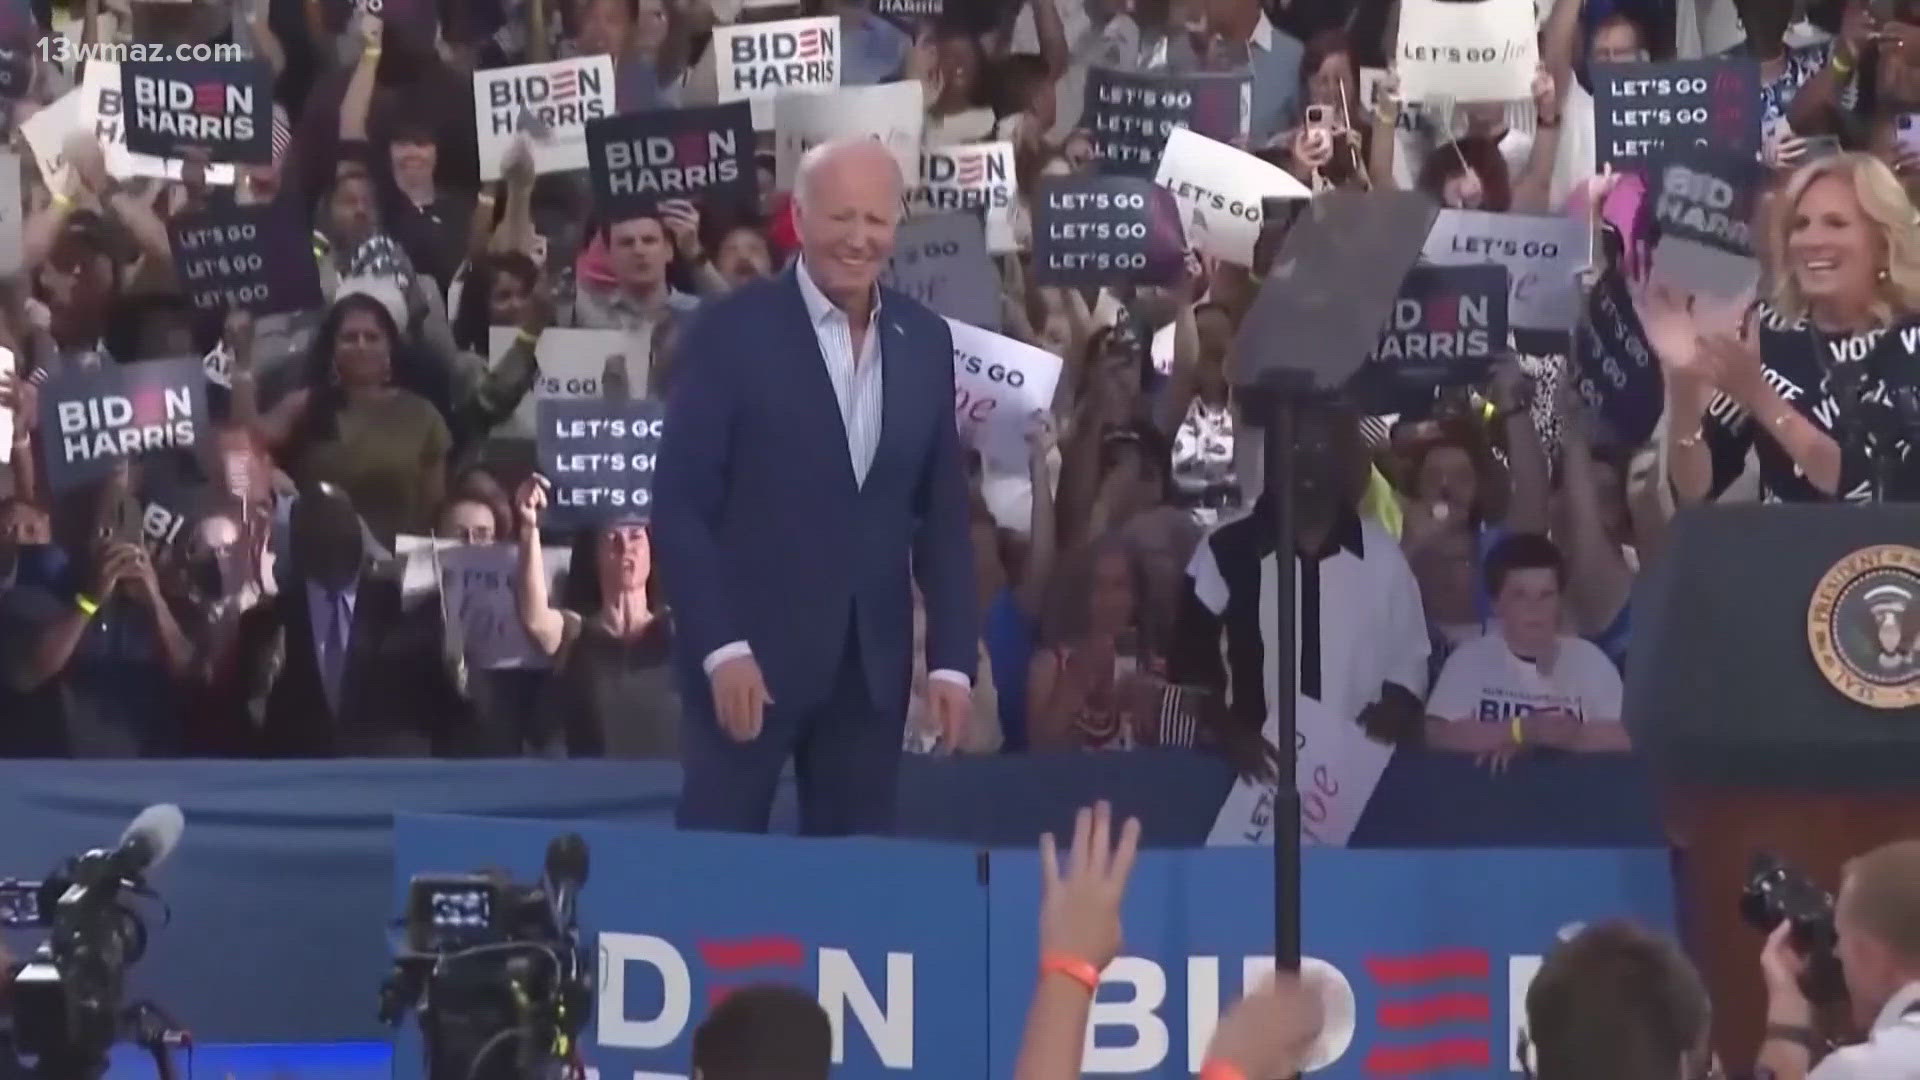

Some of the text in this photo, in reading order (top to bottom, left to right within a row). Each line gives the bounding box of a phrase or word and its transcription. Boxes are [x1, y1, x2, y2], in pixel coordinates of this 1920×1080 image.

[731, 28, 834, 64] BIDEN
[1404, 42, 1460, 63] LET'S
[1467, 48, 1496, 62] GO
[489, 68, 601, 107] BIDEN
[733, 61, 834, 90] HARRIS
[1611, 79, 1671, 97] LET'S
[1676, 78, 1707, 95] GO
[134, 75, 253, 115] BIDEN
[1100, 83, 1192, 108] LET'S GO
[136, 108, 254, 142] HARRIS
[492, 100, 605, 136] HRRIS
[1096, 112, 1154, 136] LET'S
[1612, 108, 1671, 127] LET'S
[1676, 108, 1708, 124] GO
[605, 129, 736, 170] BIDN
[1094, 141, 1150, 164] LET'S
[1613, 139, 1664, 157] LET'
[609, 159, 738, 195] HARRIS
[919, 152, 1006, 183] IDEN
[906, 185, 1009, 210] ARRIS
[1049, 192, 1144, 210] LET'S GO
[1166, 177, 1260, 222] LET'S GO
[1049, 223, 1146, 239] LET'S GO
[1452, 234, 1558, 258] LET'S GO
[1049, 253, 1146, 269] LET'S GO
[1372, 329, 1489, 361] ARRIS
[987, 363, 1025, 388] GO
[58, 385, 192, 434] BIDN
[63, 420, 195, 463] HARRIS
[556, 419, 625, 439] LET'S
[556, 454, 625, 472] LET'S
[557, 488, 650, 506] LET'S G
[1243, 788, 1275, 843] LET'
